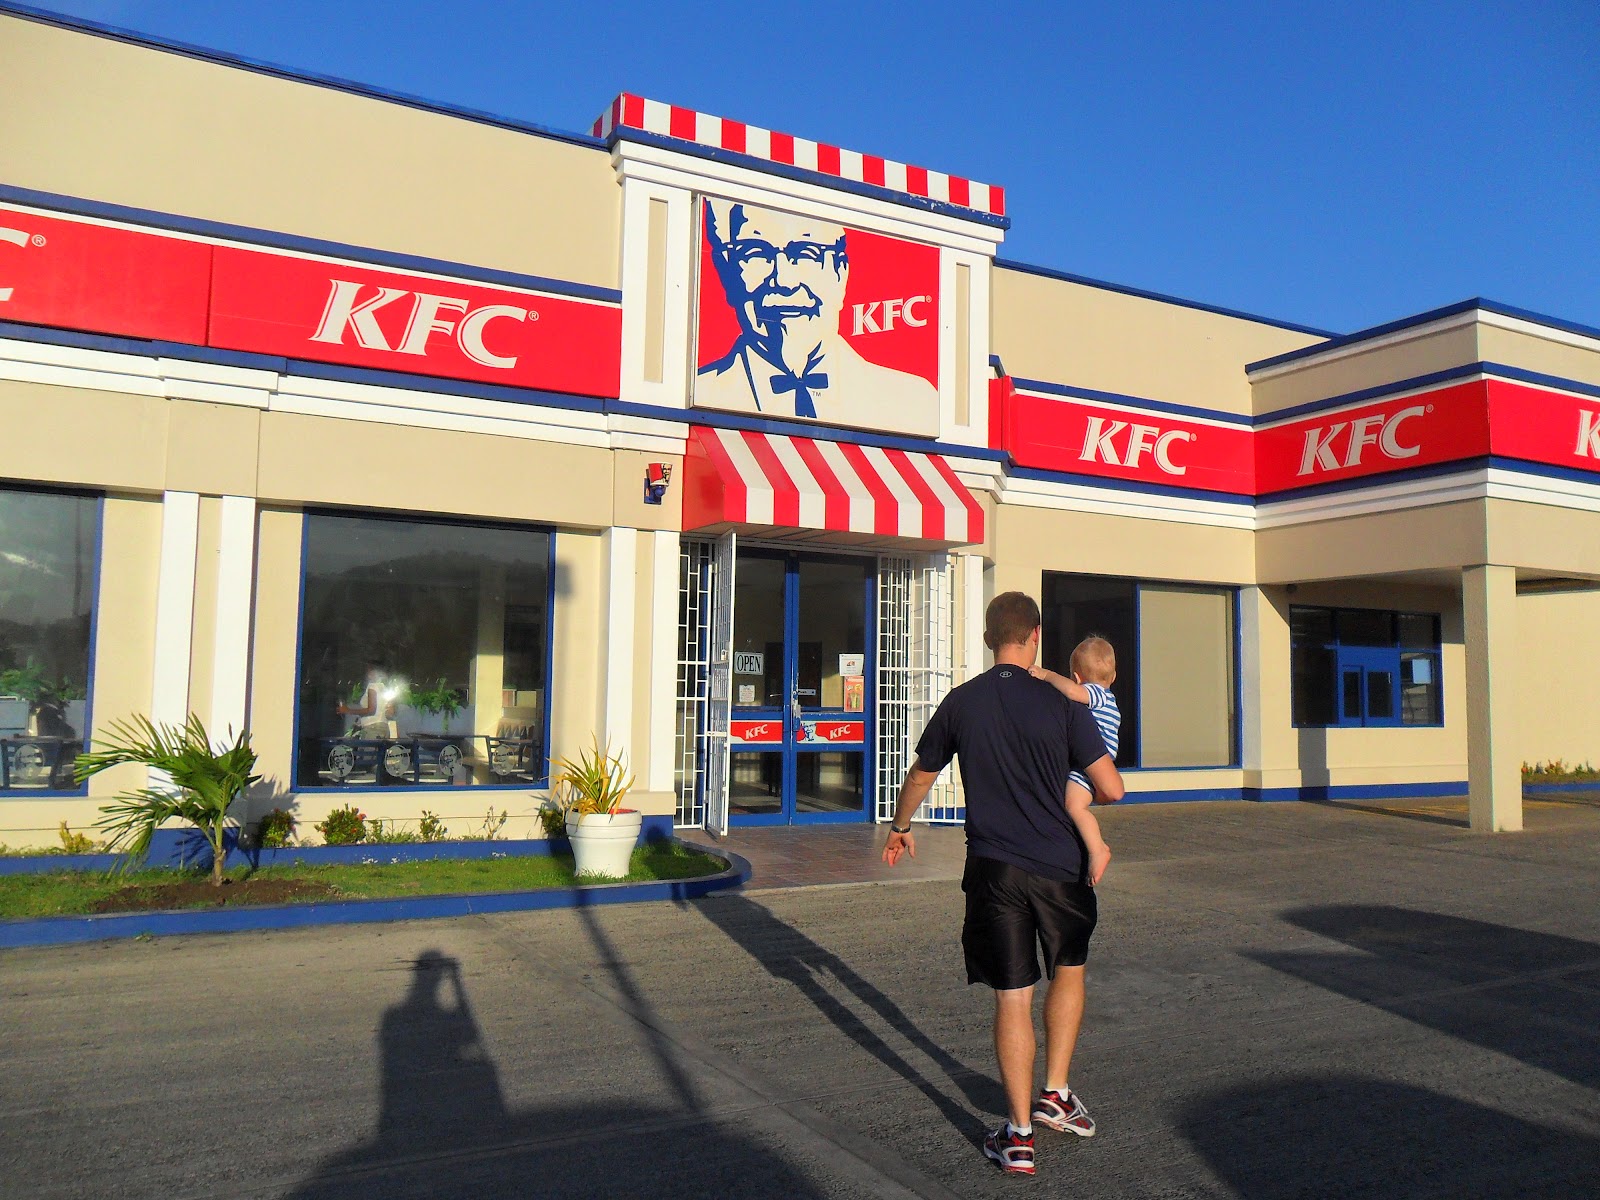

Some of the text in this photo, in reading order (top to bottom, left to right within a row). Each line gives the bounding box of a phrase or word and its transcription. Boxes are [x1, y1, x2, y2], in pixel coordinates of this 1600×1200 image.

[308, 278, 527, 369] KFC
[851, 295, 928, 337] KFC
[1077, 415, 1190, 475] KFC
[1296, 405, 1425, 476] KFC
[737, 654, 761, 672] OPEN
[745, 724, 768, 740] KFC
[829, 724, 851, 740] KFC
